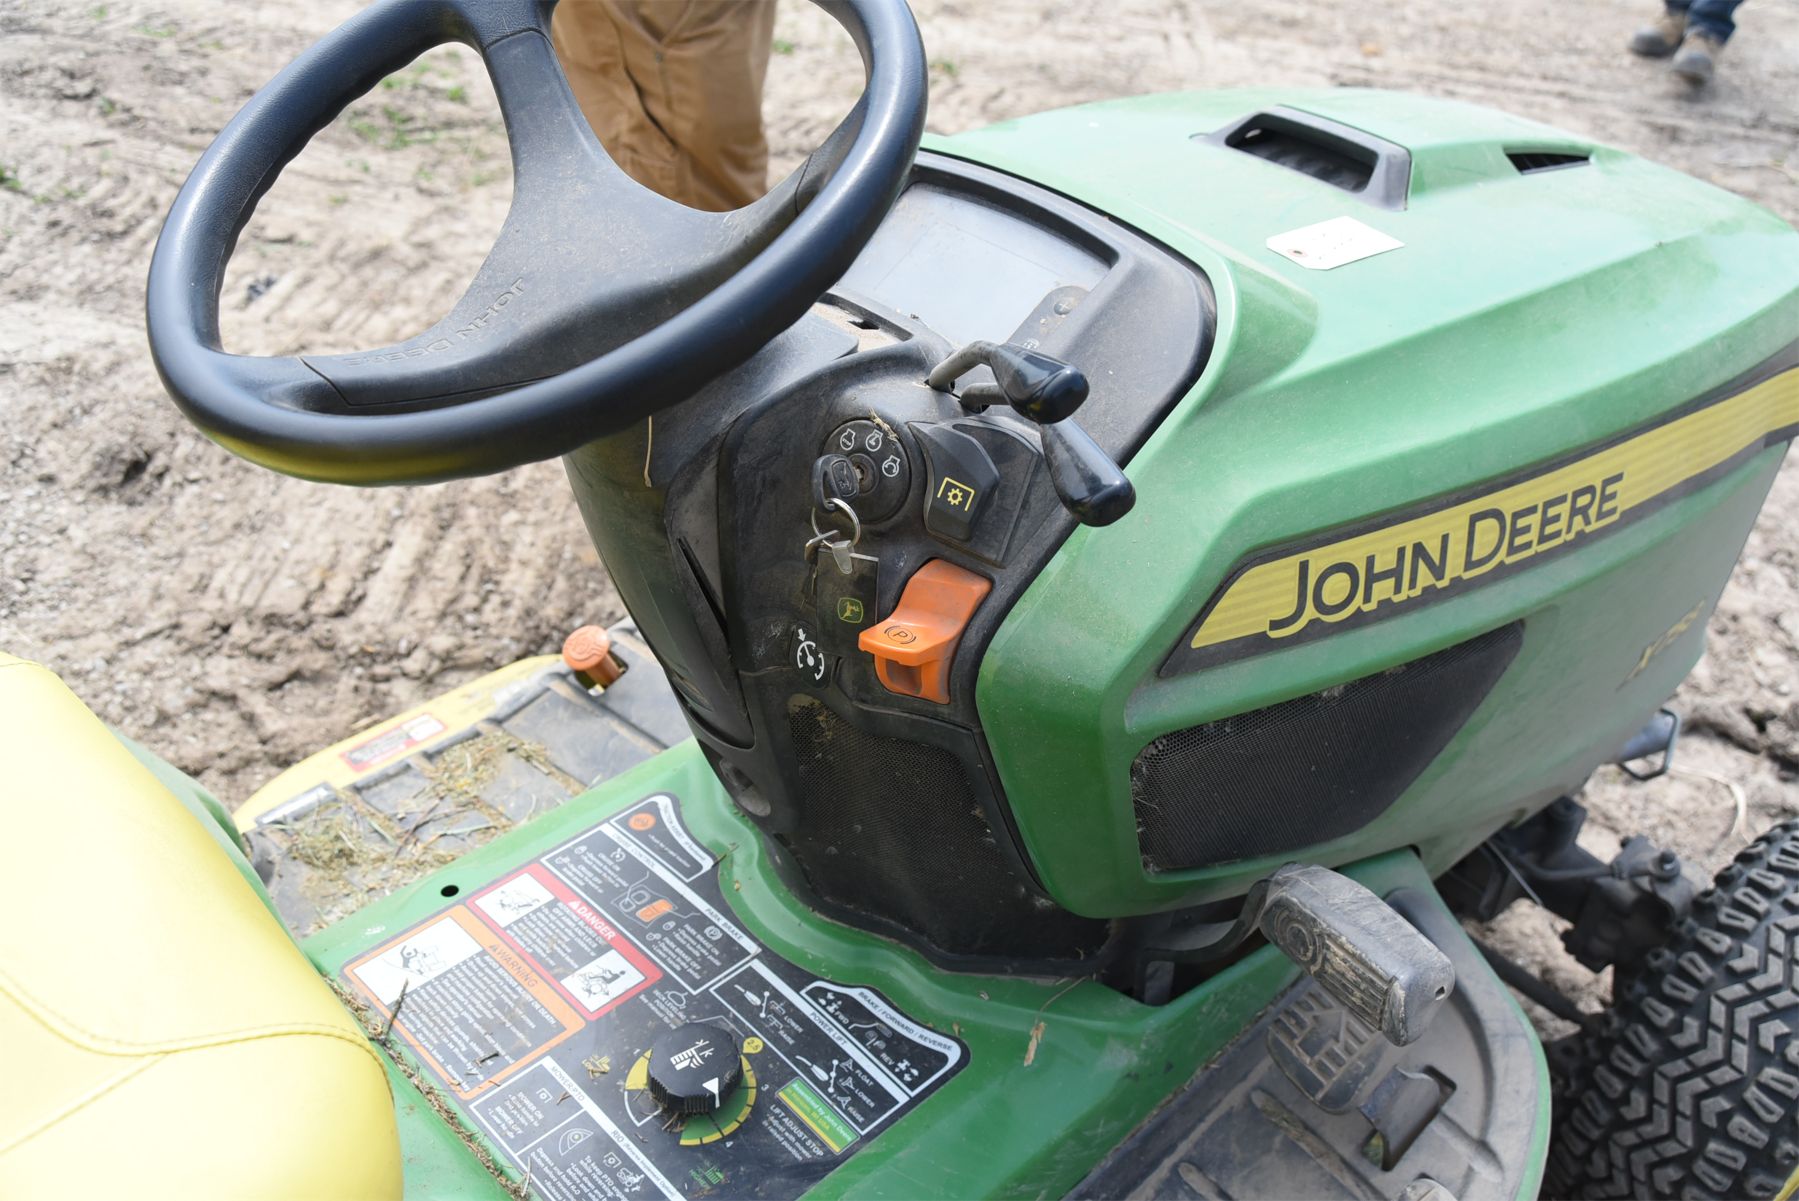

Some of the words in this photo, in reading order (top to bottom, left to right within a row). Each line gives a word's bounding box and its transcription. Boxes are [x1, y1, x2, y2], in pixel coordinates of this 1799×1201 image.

[456, 276, 525, 340] JOHN
[1268, 532, 1451, 634] JOHN
[1464, 471, 1625, 572] DEERE
[574, 905, 618, 941] DANGER
[493, 947, 539, 988] WARNING
[652, 998, 676, 1019] POSITION
[833, 1010, 850, 1024] FWD
[782, 1015, 803, 1033] LOWER
[808, 1011, 834, 1034] POWER
[831, 1032, 847, 1046] LIFT
[856, 991, 880, 1009] BRAKE
[880, 1010, 915, 1034] FORWARD
[916, 1033, 954, 1051] REVERSE
[744, 1036, 762, 1053] 2.5
[777, 1029, 795, 1045] RAISE
[631, 1047, 642, 1055] 1
[878, 1052, 896, 1066] REV
[759, 1082, 770, 1092] 3
[853, 1068, 874, 1087] FLOAT
[853, 1088, 876, 1108] LOWER
[845, 1105, 865, 1123] RAISE
[609, 1129, 625, 1143] RIO
[766, 1114, 787, 1133] Adjust
[783, 1130, 797, 1143] with
[793, 1141, 812, 1159] mower
[769, 1103, 785, 1118] LIFT
[780, 1115, 808, 1141] ADJUST
[804, 1138, 825, 1158] STOP
[822, 1113, 838, 1128] John
[834, 1125, 853, 1142] Deere
[723, 1138, 734, 1148] 4
[766, 1125, 784, 1142] raised
[780, 1139, 804, 1161] position
[583, 1154, 594, 1164] To
[588, 1160, 605, 1176] keep
[580, 1175, 596, 1190] down
[592, 1188, 604, 1199] and
[600, 1173, 615, 1187] PTO
